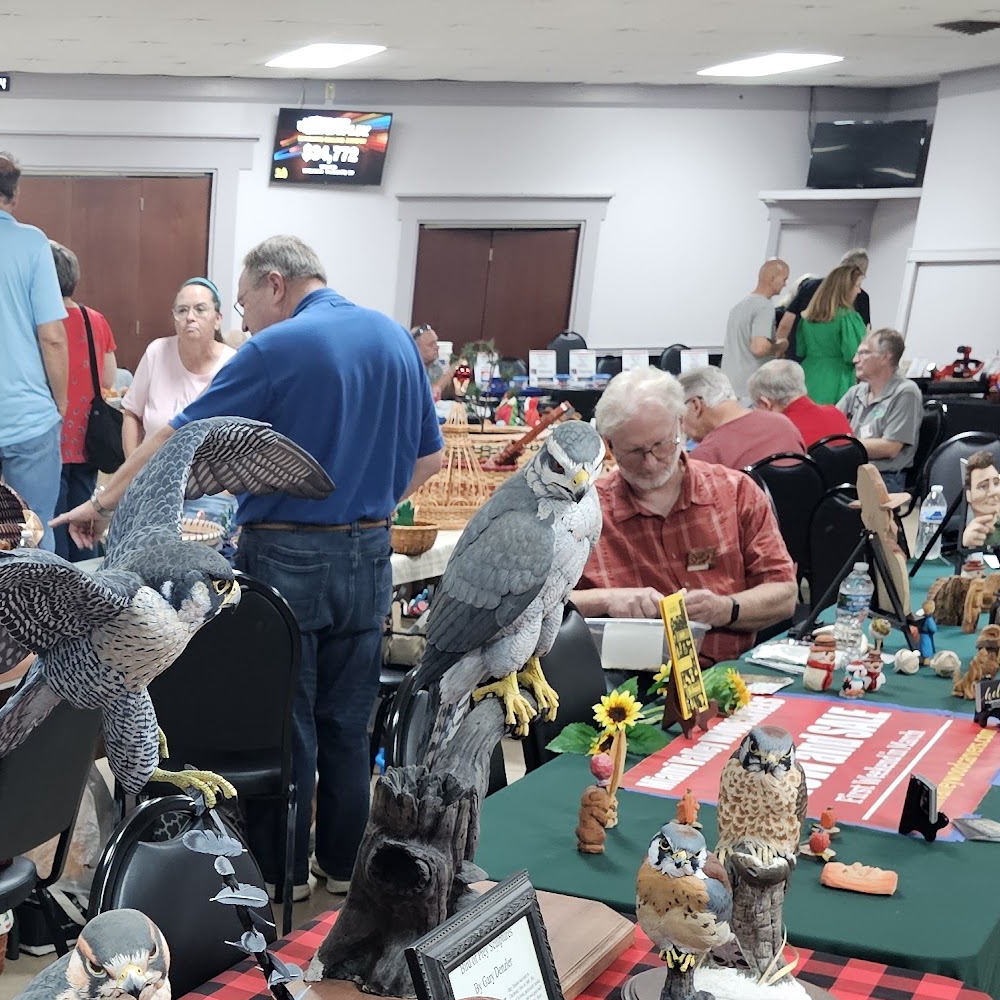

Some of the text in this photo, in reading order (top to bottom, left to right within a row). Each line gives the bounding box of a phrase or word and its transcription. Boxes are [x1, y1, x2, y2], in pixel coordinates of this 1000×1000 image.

[806, 706, 892, 739] SALE
[473, 957, 513, 995] By Gary Denzler
